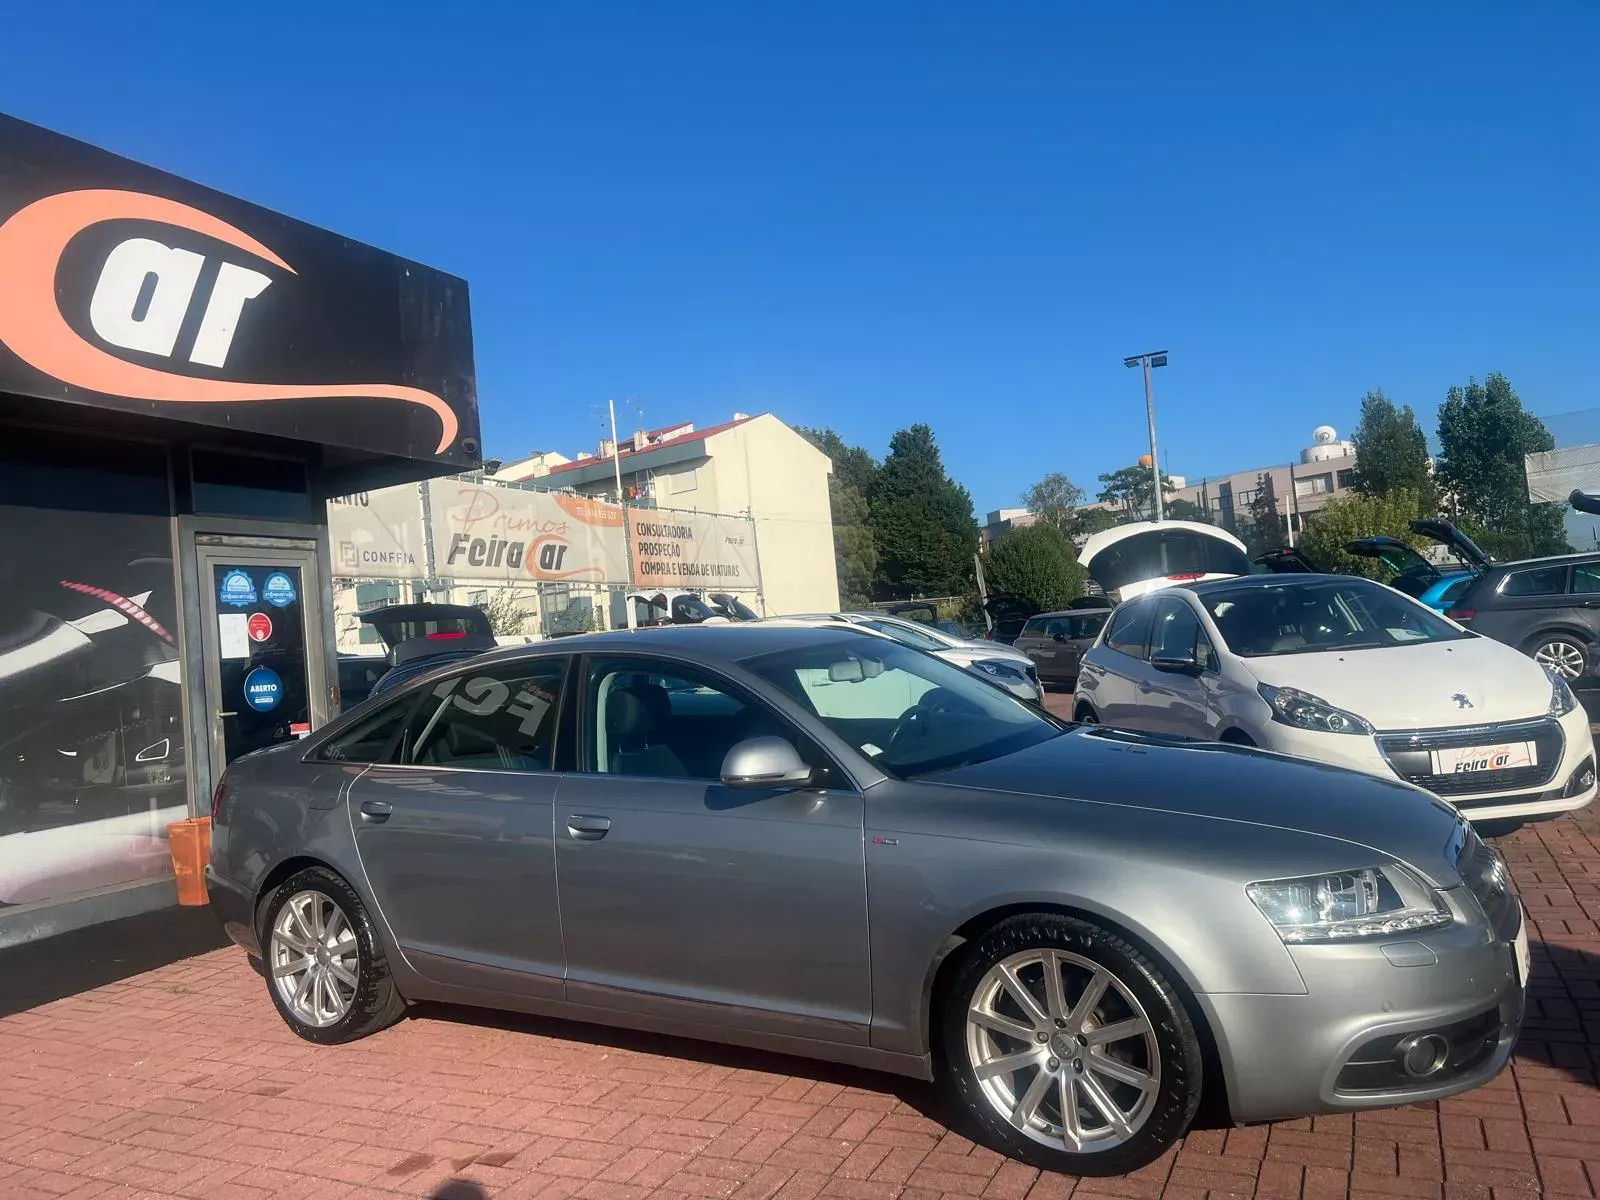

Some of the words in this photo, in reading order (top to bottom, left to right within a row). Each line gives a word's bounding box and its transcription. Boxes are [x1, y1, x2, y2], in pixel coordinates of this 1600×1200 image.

[452, 489, 571, 535] Primos
[636, 522, 693, 540] CONSULTADORIA
[362, 550, 415, 565] CONFFIA
[638, 541, 681, 559] PROSPEÇÃO
[640, 561, 671, 575] COMPRA
[672, 562, 677, 575] E
[677, 562, 700, 576] VENDA
[701, 563, 710, 576] DE
[710, 563, 740, 577] VIATURAS
[250, 684, 277, 693] ABERTO
